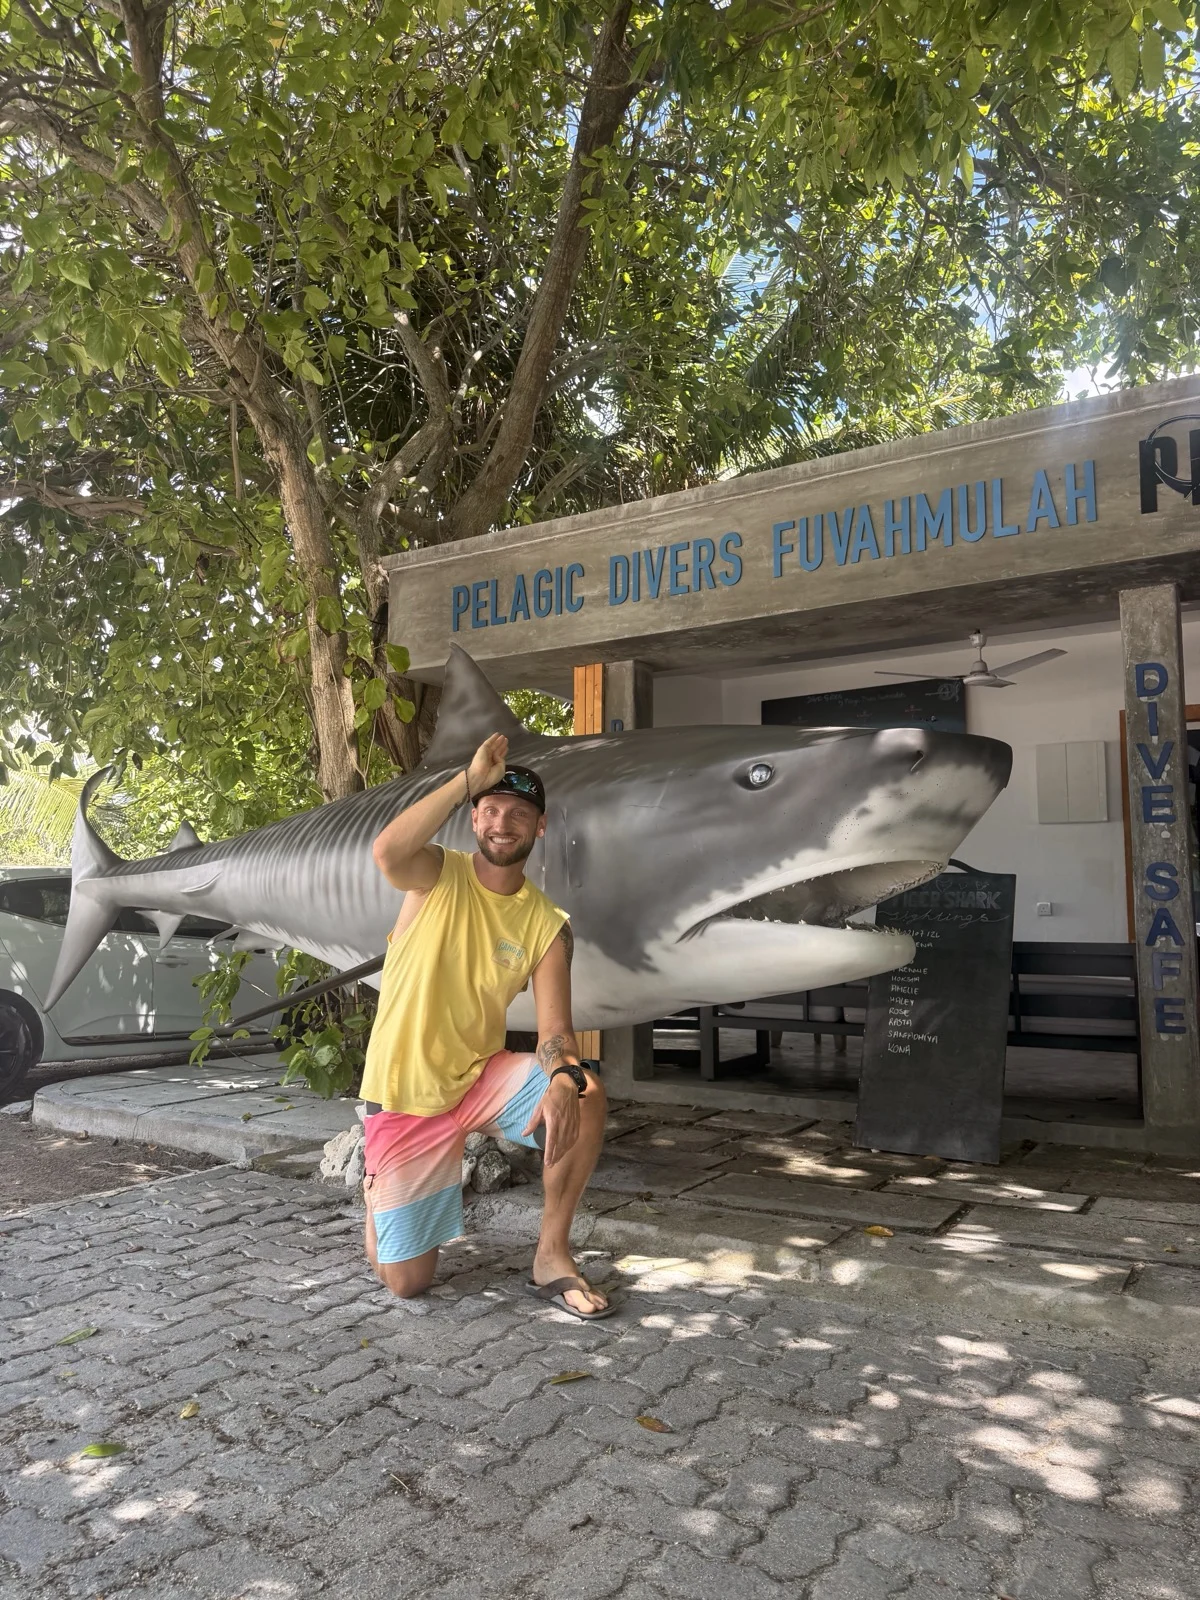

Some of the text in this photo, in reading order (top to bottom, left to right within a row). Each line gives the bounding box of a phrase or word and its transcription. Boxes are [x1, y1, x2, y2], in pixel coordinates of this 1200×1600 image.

[452, 459, 1098, 632] PELAGIC DIVERS FUVAHMULAH
[1135, 662, 1187, 1035] DIVE SAFE
[944, 891, 1003, 909] SHARK
[887, 1042, 911, 1056] KONA
